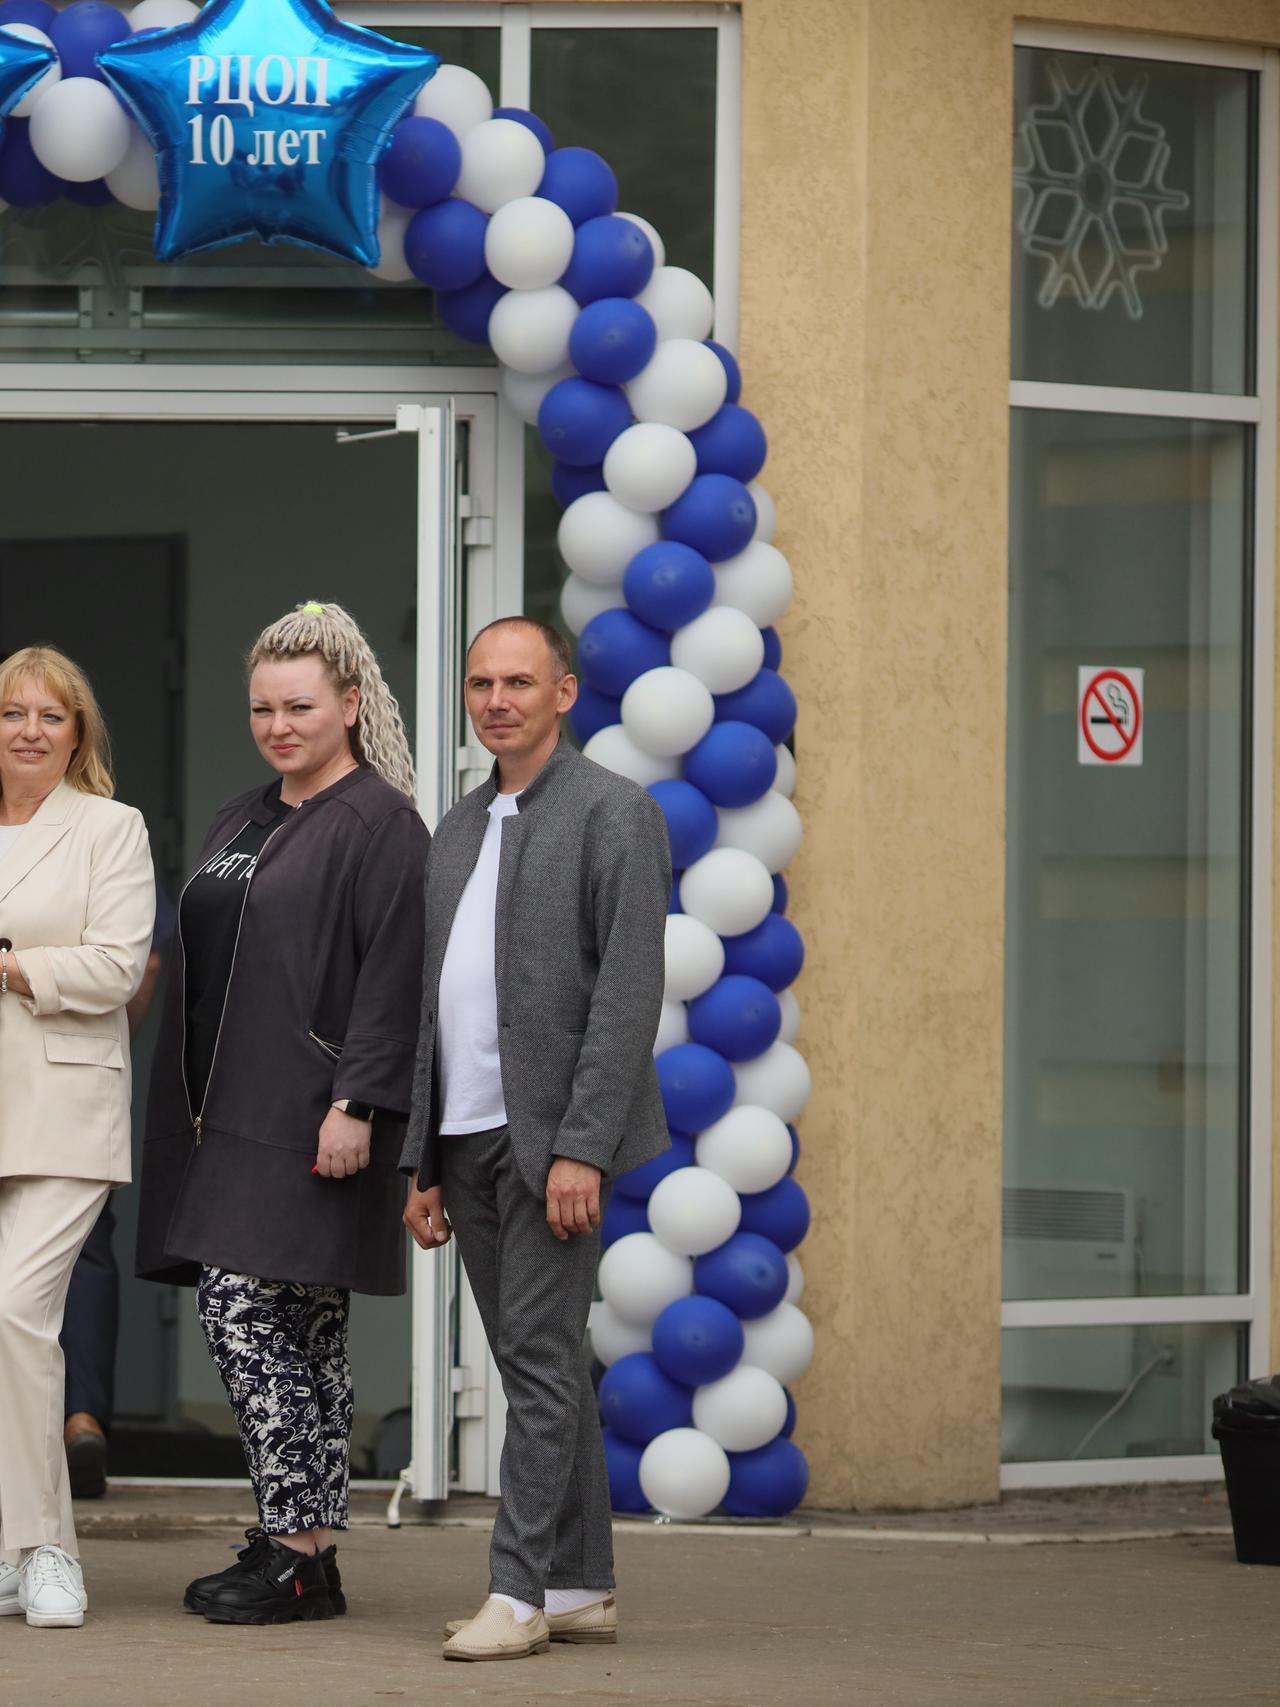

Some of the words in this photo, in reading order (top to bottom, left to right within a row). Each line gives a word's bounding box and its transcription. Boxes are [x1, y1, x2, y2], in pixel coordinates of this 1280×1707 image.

[184, 54, 331, 117] РЦОП
[187, 114, 235, 166] 10
[246, 129, 327, 166] лет
